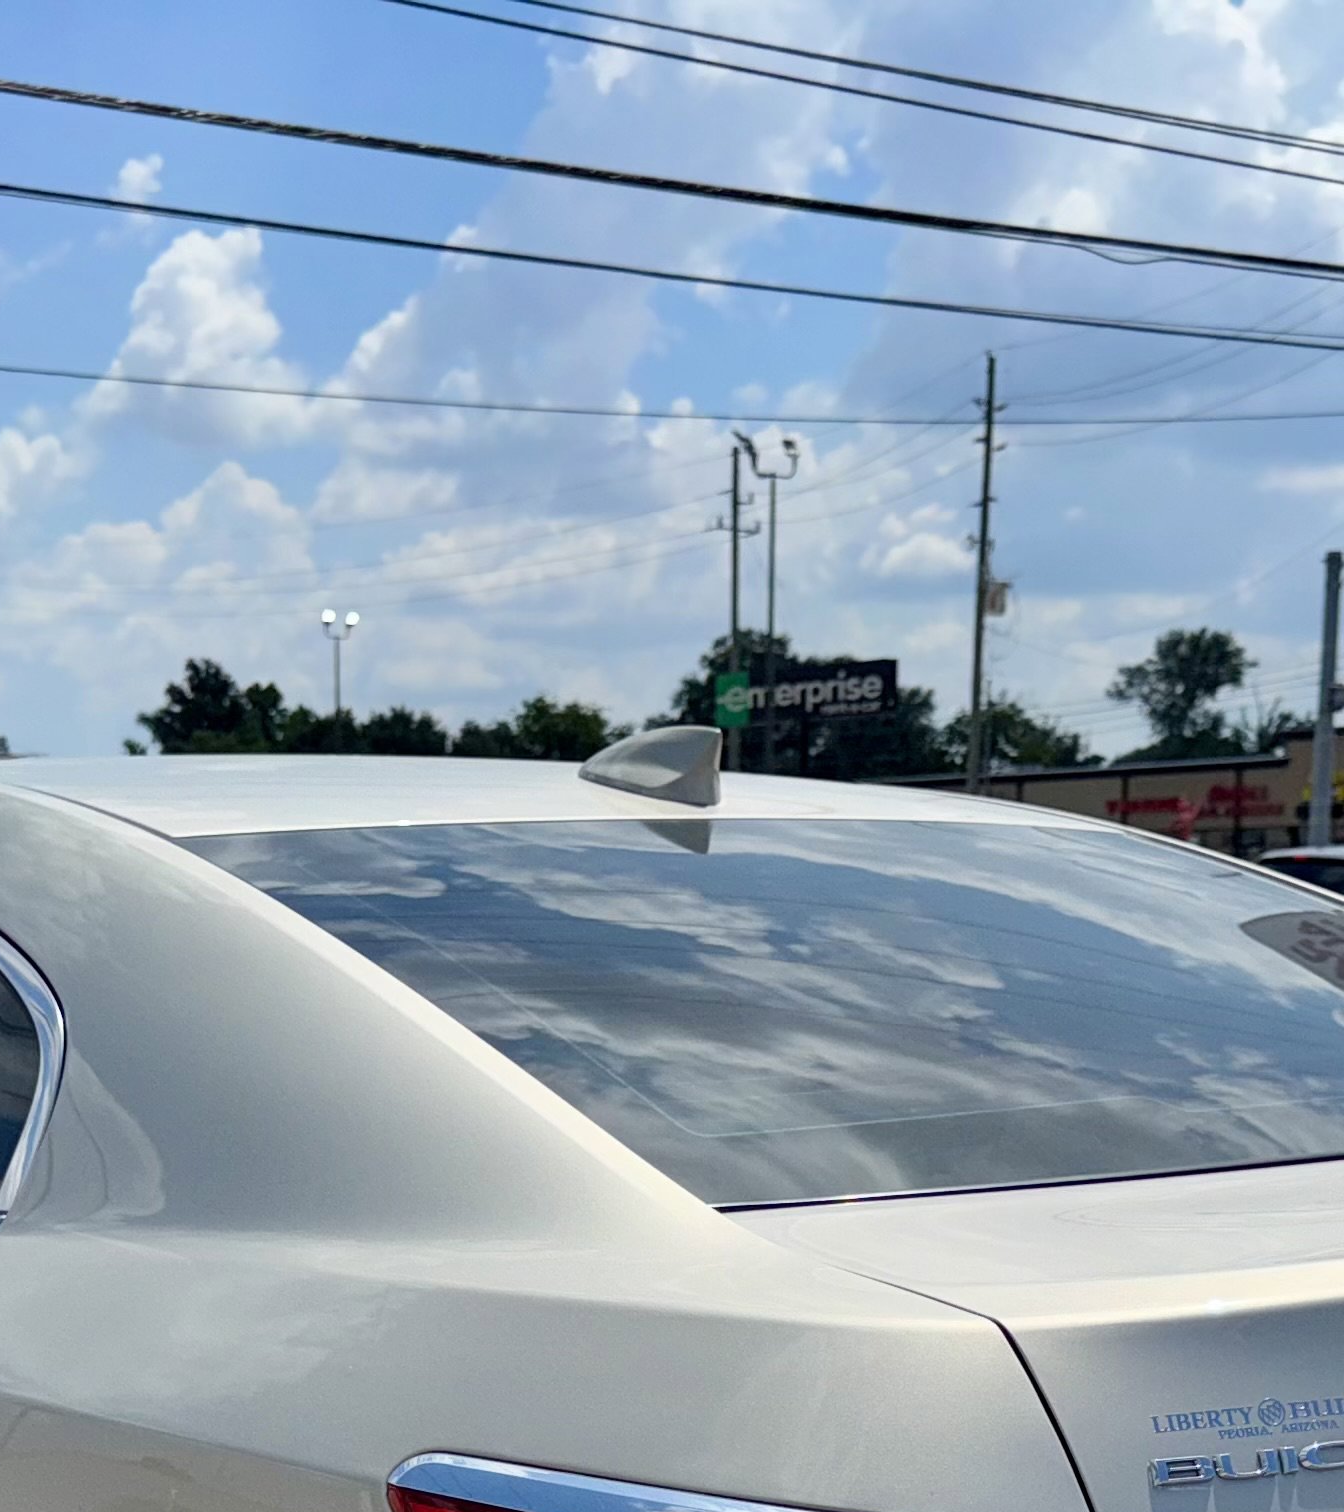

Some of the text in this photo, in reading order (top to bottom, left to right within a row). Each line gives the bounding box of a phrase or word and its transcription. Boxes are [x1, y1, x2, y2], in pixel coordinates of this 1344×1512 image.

[717, 669, 884, 713] enerprise
[1150, 1406, 1253, 1434] LIBERTY
[1281, 1418, 1339, 1434] ARIZONA
